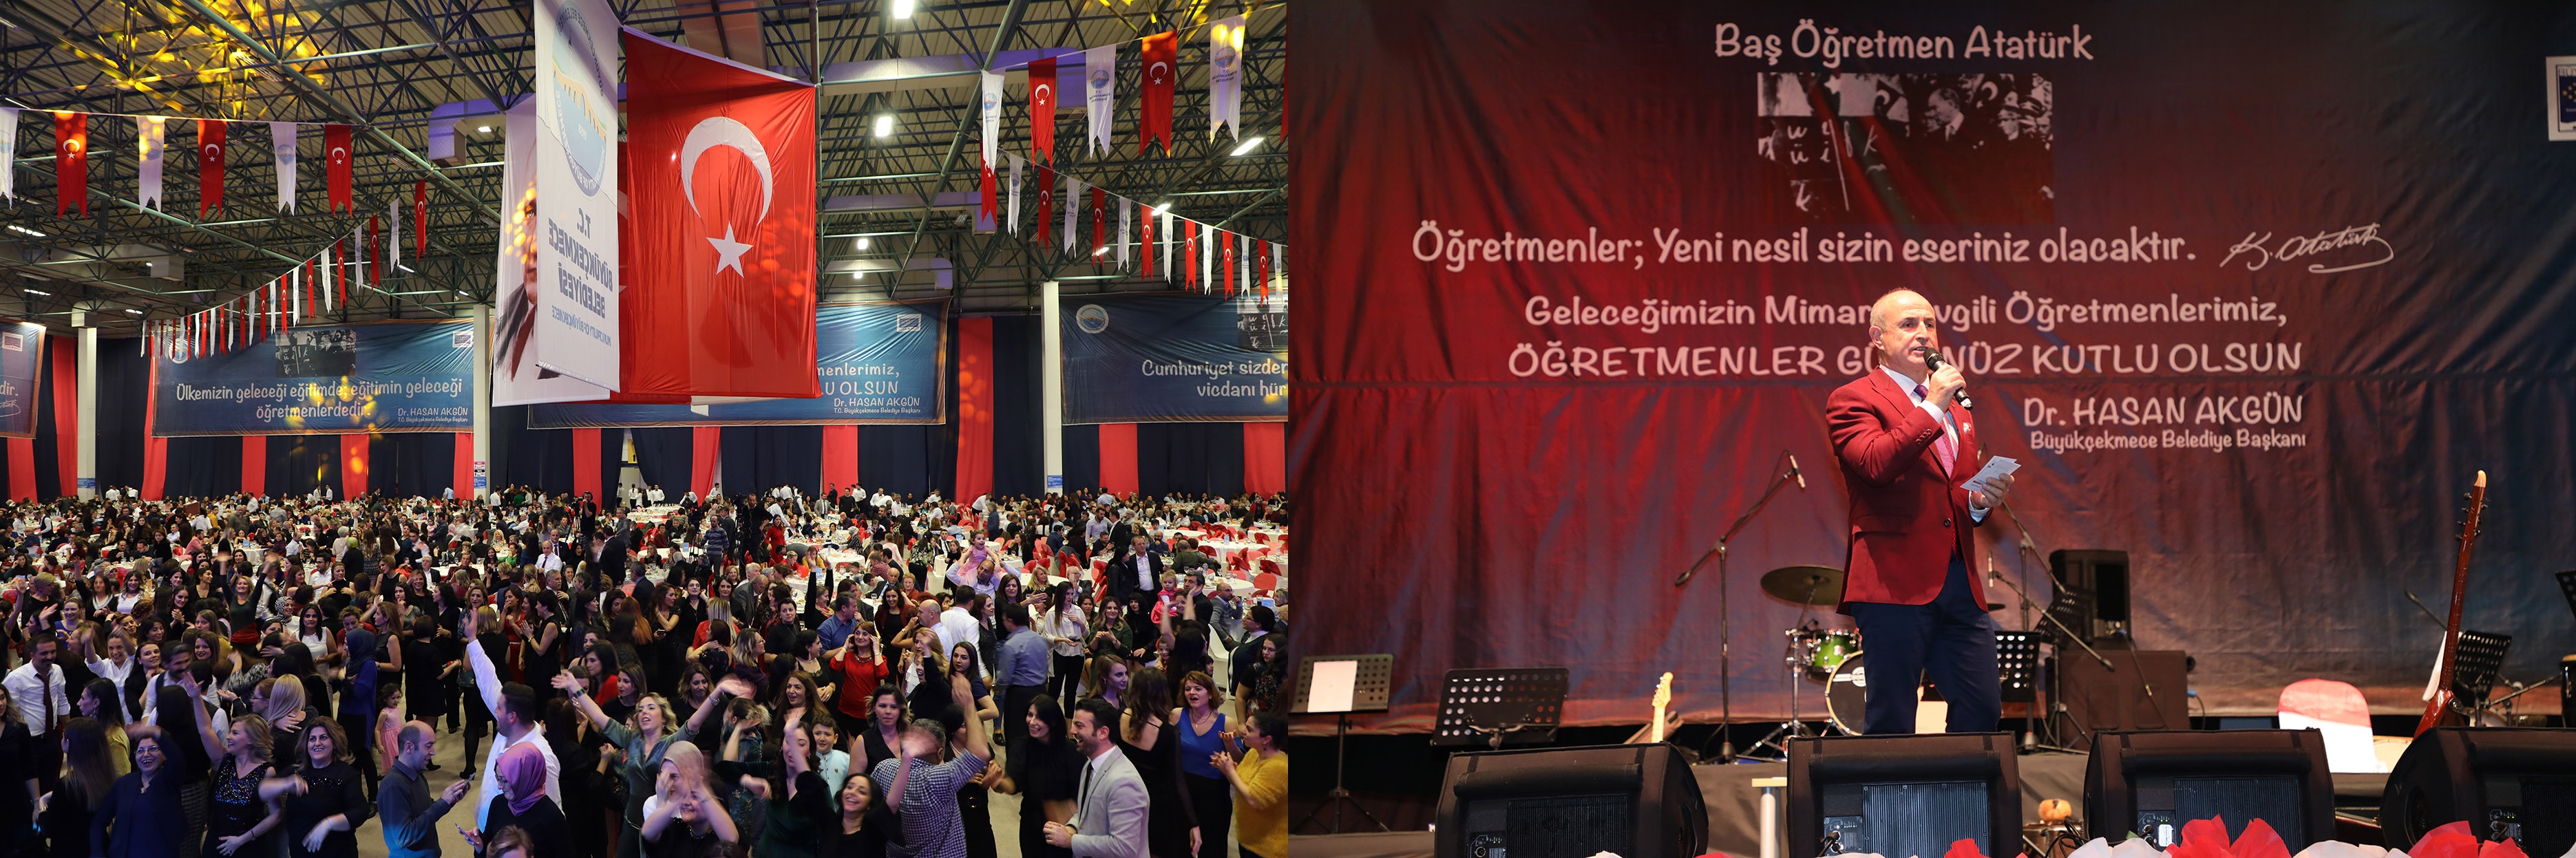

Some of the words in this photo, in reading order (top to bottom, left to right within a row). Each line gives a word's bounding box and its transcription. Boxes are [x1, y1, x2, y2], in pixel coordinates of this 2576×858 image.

[1715, 23, 1783, 65] Baş
[1791, 19, 1954, 68] Öğretmen
[1964, 24, 2093, 61] Atatürk
[1413, 219, 1644, 272] Öğretmenler;
[1653, 227, 1723, 264] Yeni
[1732, 226, 1809, 264] nesil
[1817, 231, 1893, 264] sizin
[1902, 231, 2030, 264] eseriniz
[2039, 225, 2196, 264] olacaktır.
[1525, 295, 1755, 334] Geleceğimizin
[1764, 295, 1872, 325] Mimar
[2005, 290, 2287, 332] Öğretmenlerimiz,
[1142, 359, 1234, 380] Cumhuriyet
[1508, 341, 1826, 378] ÖĞRETMENLER
[2032, 343, 2160, 374] KUTLU
[2168, 342, 2302, 373] OLSUN
[176, 383, 233, 400] Ülkemizin
[236, 383, 287, 403] geleceği
[350, 380, 402, 400] eğitimin
[405, 376, 463, 398] geleceği
[840, 380, 898, 395] OLSUN
[1196, 380, 1255, 397] vicdanı
[1260, 379, 1287, 397] hür
[398, 407, 409, 416] Dr.
[410, 407, 439, 416] HASAN
[441, 406, 468, 416] AKGÜN
[834, 397, 847, 407] Dr.
[849, 397, 885, 407] HASAN
[887, 396, 920, 407] AKGÜN
[2024, 396, 2066, 427] Dr.
[2073, 396, 2186, 427] HASAN
[2195, 391, 2303, 425] AKGÜN
[2031, 431, 2157, 454] Büyükçekmece
[2162, 429, 2232, 452] Belediye
[2237, 427, 2306, 451] Başkanı
